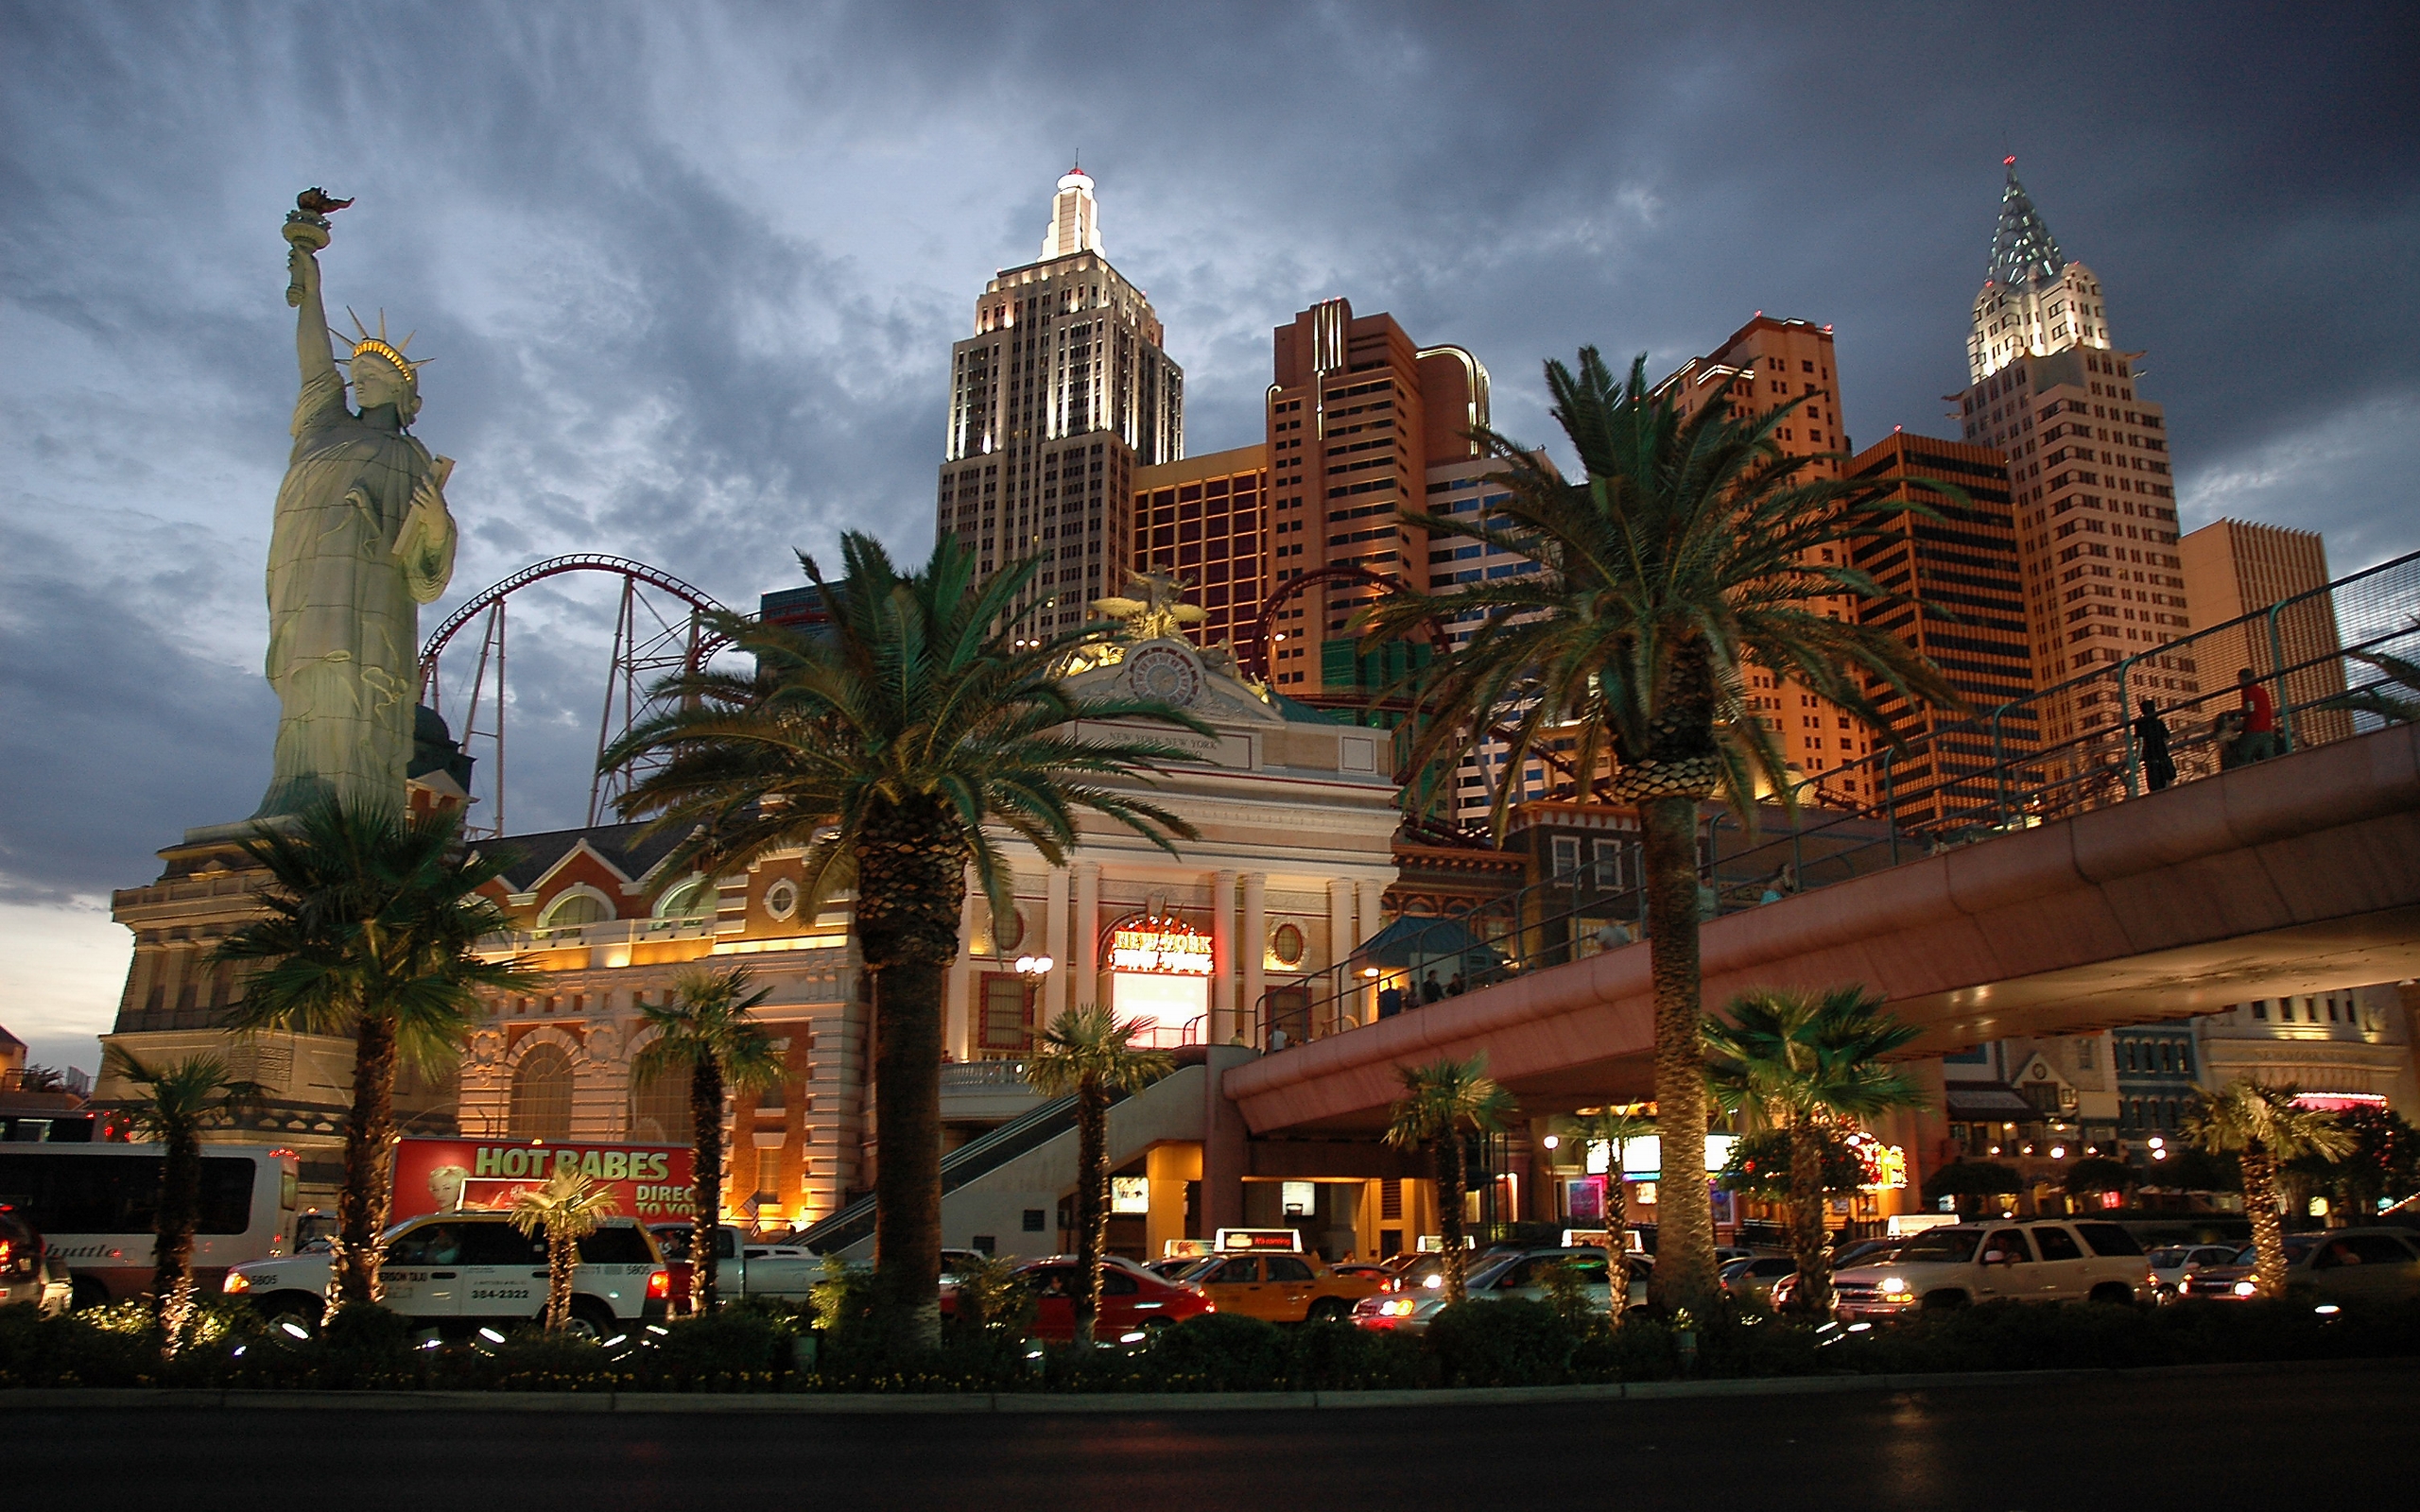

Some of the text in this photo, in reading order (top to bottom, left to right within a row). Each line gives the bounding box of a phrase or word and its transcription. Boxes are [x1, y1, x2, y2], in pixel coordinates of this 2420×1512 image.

[1115, 931, 1213, 954] NEW YORK
[475, 1147, 669, 1181] HOT BABES
[636, 1184, 695, 1202] DIREC
[635, 1202, 662, 1218] TO
[44, 1244, 117, 1258] huttle
